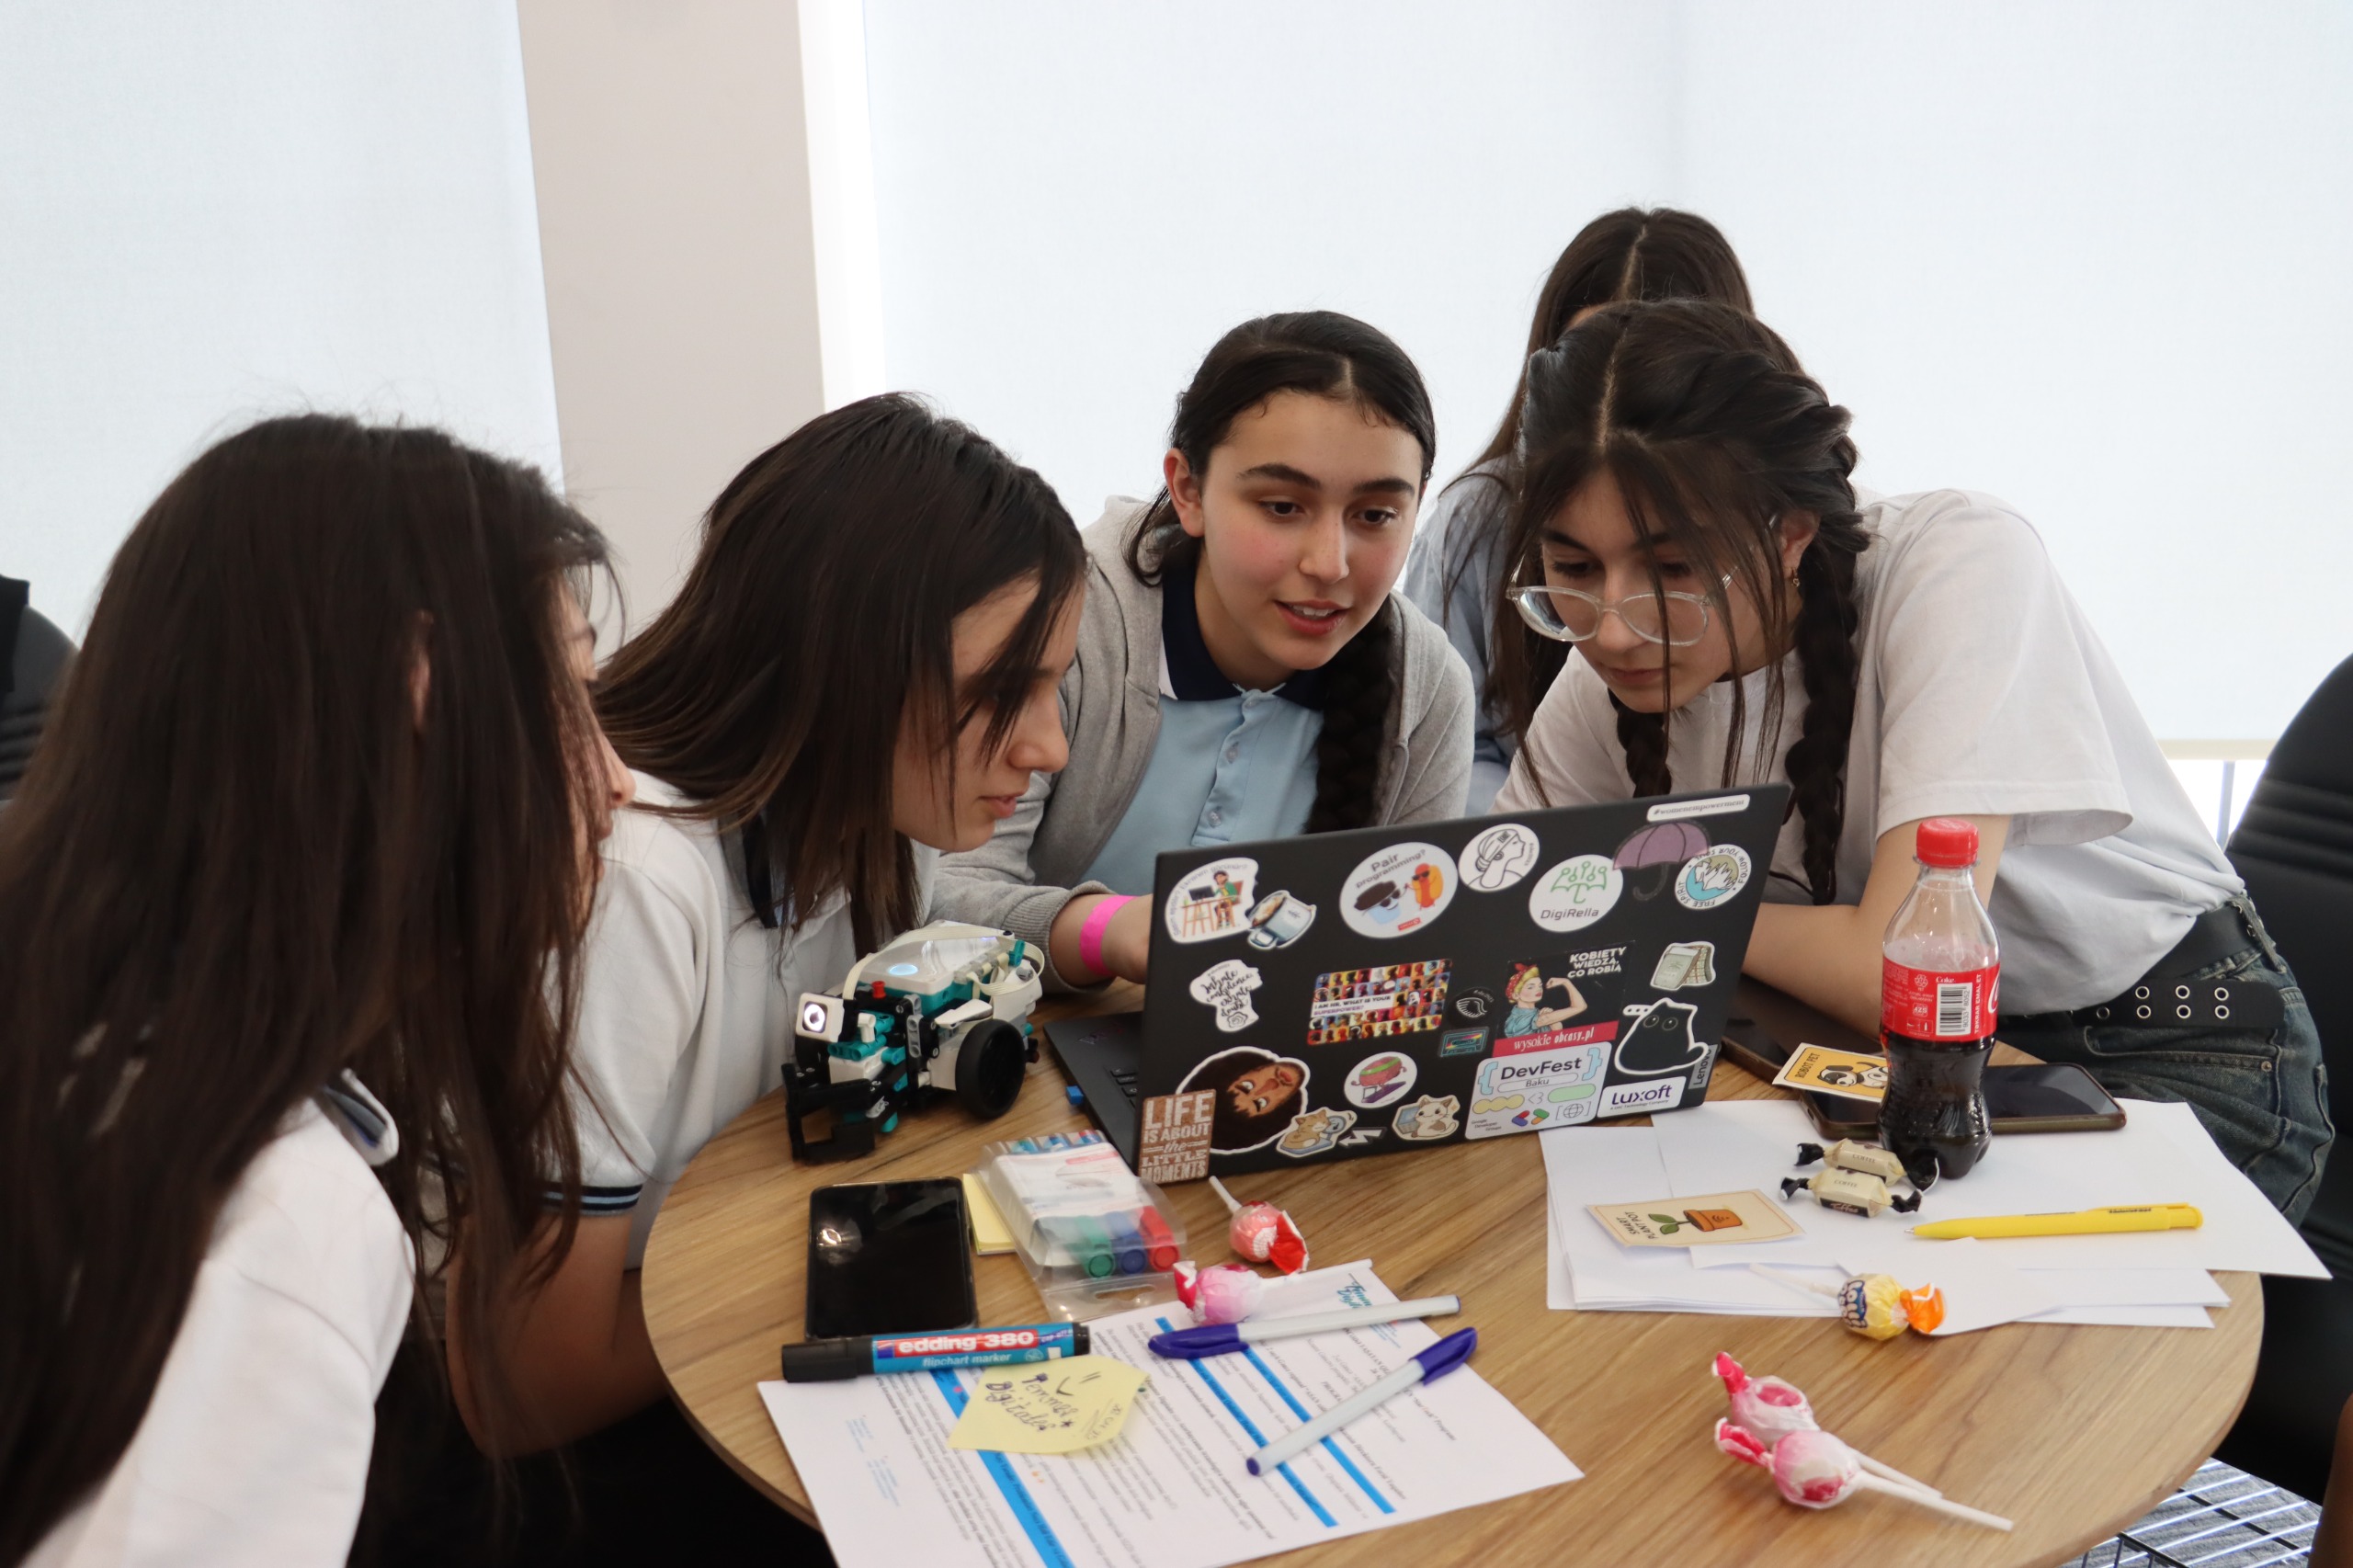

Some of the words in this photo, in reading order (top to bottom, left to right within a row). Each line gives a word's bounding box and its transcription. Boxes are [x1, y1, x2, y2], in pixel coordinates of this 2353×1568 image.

[1356, 848, 1426, 889] programming?
[1371, 854, 1399, 872] Pair
[1540, 907, 1599, 921] DigiRella
[1569, 946, 1627, 963] KOBIETY
[1567, 969, 1586, 979] CO
[1514, 1033, 1552, 1051] wysokie
[1554, 1027, 1595, 1044] obcasy.pl
[1501, 1057, 1582, 1080] DevFest
[1794, 1062, 1814, 1079] ROBOT
[1526, 1078, 1550, 1088] Baku
[1611, 1085, 1672, 1106] Luxoft
[1145, 1093, 1213, 1130] LIFE
[1143, 1129, 1158, 1143] IS
[1161, 1122, 1210, 1141] ABOUT
[1164, 1141, 1188, 1153] the
[1142, 1149, 1208, 1167] LITTLE
[1852, 1153, 1876, 1164] COFFEE
[1141, 1160, 1206, 1185] MOMENTS
[1834, 1179, 1858, 1188] COFFEE
[1616, 1216, 1640, 1235] SMART
[1635, 1220, 1658, 1240] PLANT
[898, 1335, 978, 1354] edding
[983, 1331, 1035, 1348] 380
[922, 1355, 969, 1368] flipchart
[972, 1353, 1012, 1364] marker
